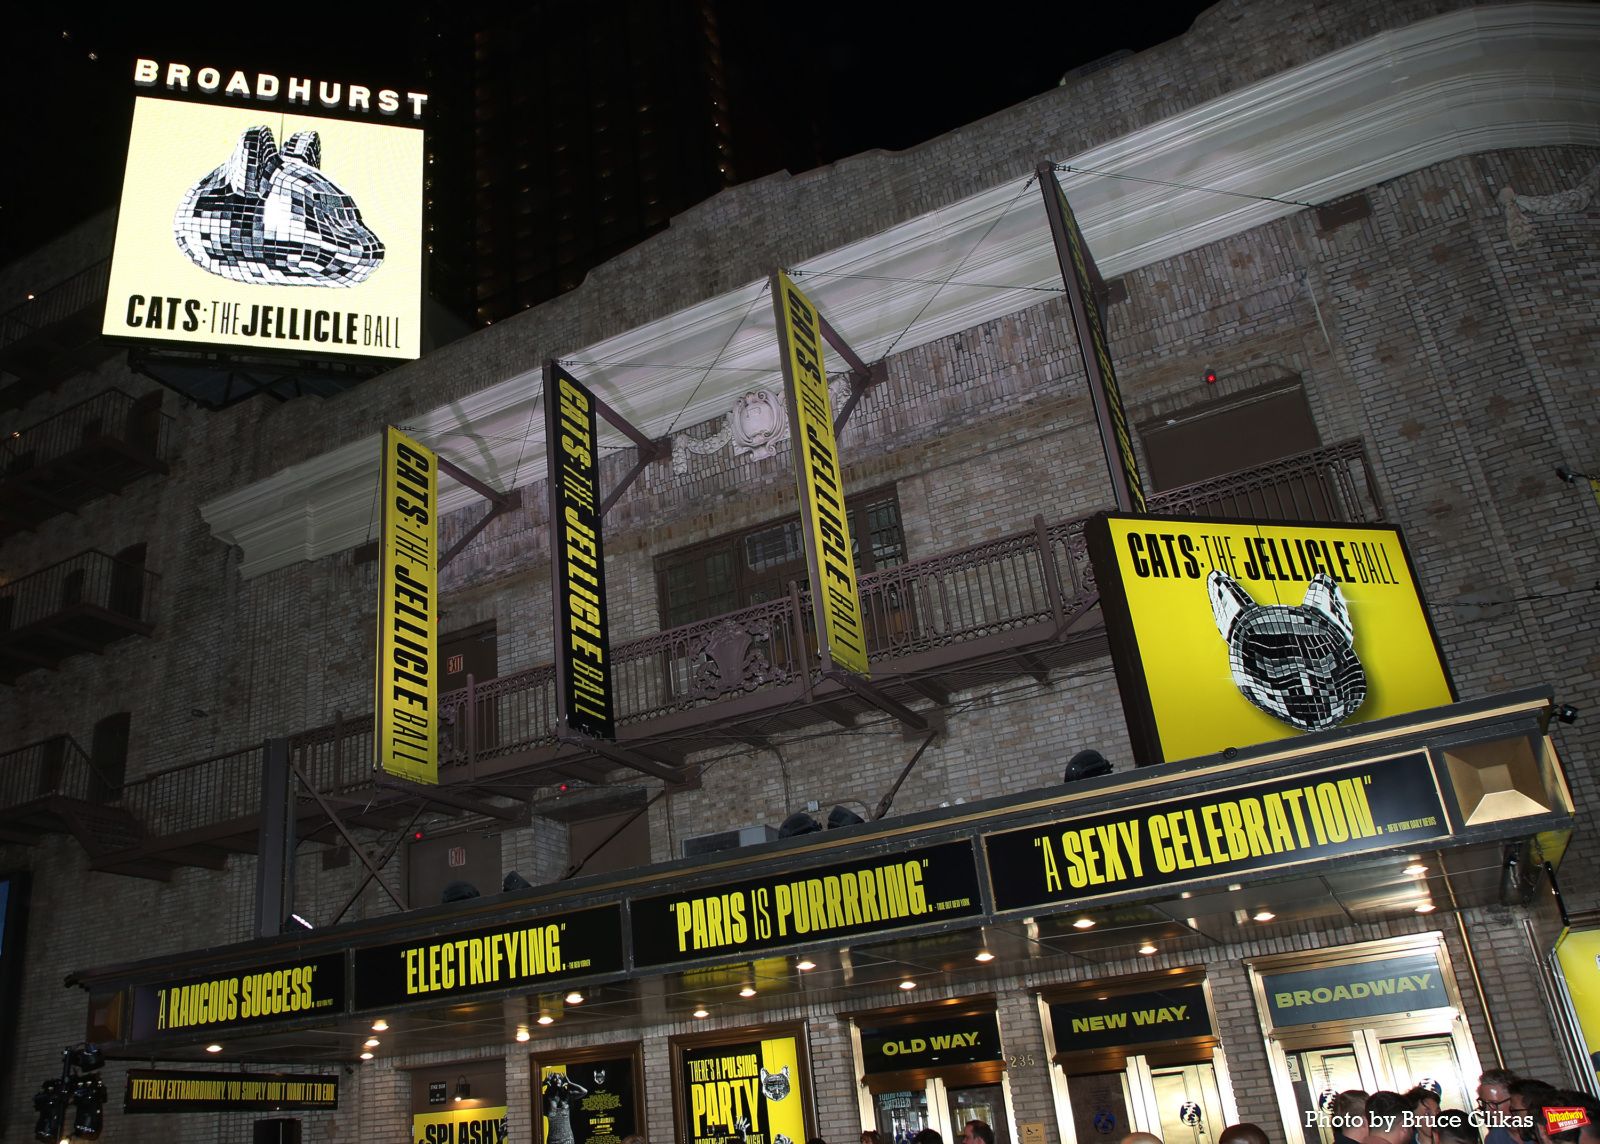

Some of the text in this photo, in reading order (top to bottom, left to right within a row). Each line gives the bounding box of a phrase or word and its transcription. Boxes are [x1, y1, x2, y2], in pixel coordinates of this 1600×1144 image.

[134, 58, 428, 119] BROADHURST
[126, 294, 401, 349] CATS: THE JELLICLE BALL
[800, 380, 829, 438] THE
[563, 463, 594, 517] THE
[807, 423, 853, 597] JELLICLE
[394, 522, 429, 572] THE
[1127, 532, 1400, 585] CATS: THE JELLICLE BALL
[565, 505, 603, 665] JELLICLE
[393, 563, 429, 712] JELLICLE
[828, 584, 861, 656] BALL
[573, 656, 606, 721] BALL
[392, 707, 428, 765] BALL
[1034, 775, 1383, 893] "A SEXY CELEBRATION."
[670, 858, 934, 952] "PARIS IS PURRRRING."
[400, 922, 567, 995] "ELECTRIFYING."
[168, 975, 239, 1029] RAUCOUS
[1072, 1005, 1190, 1034] NEW WAY.
[1275, 973, 1435, 1009] BROADWAY.
[715, 1058, 722, 1080] A
[721, 1054, 759, 1079] PULSING
[882, 1031, 981, 1056] OLD WAY.
[1010, 1054, 1035, 1068] 235
[227, 1081, 242, 1100] YOU
[242, 1081, 267, 1101] SIMPLY
[286, 1082, 306, 1101] WANT
[306, 1083, 313, 1101] IT
[314, 1083, 322, 1101] TO
[691, 1077, 760, 1138] PARTY
